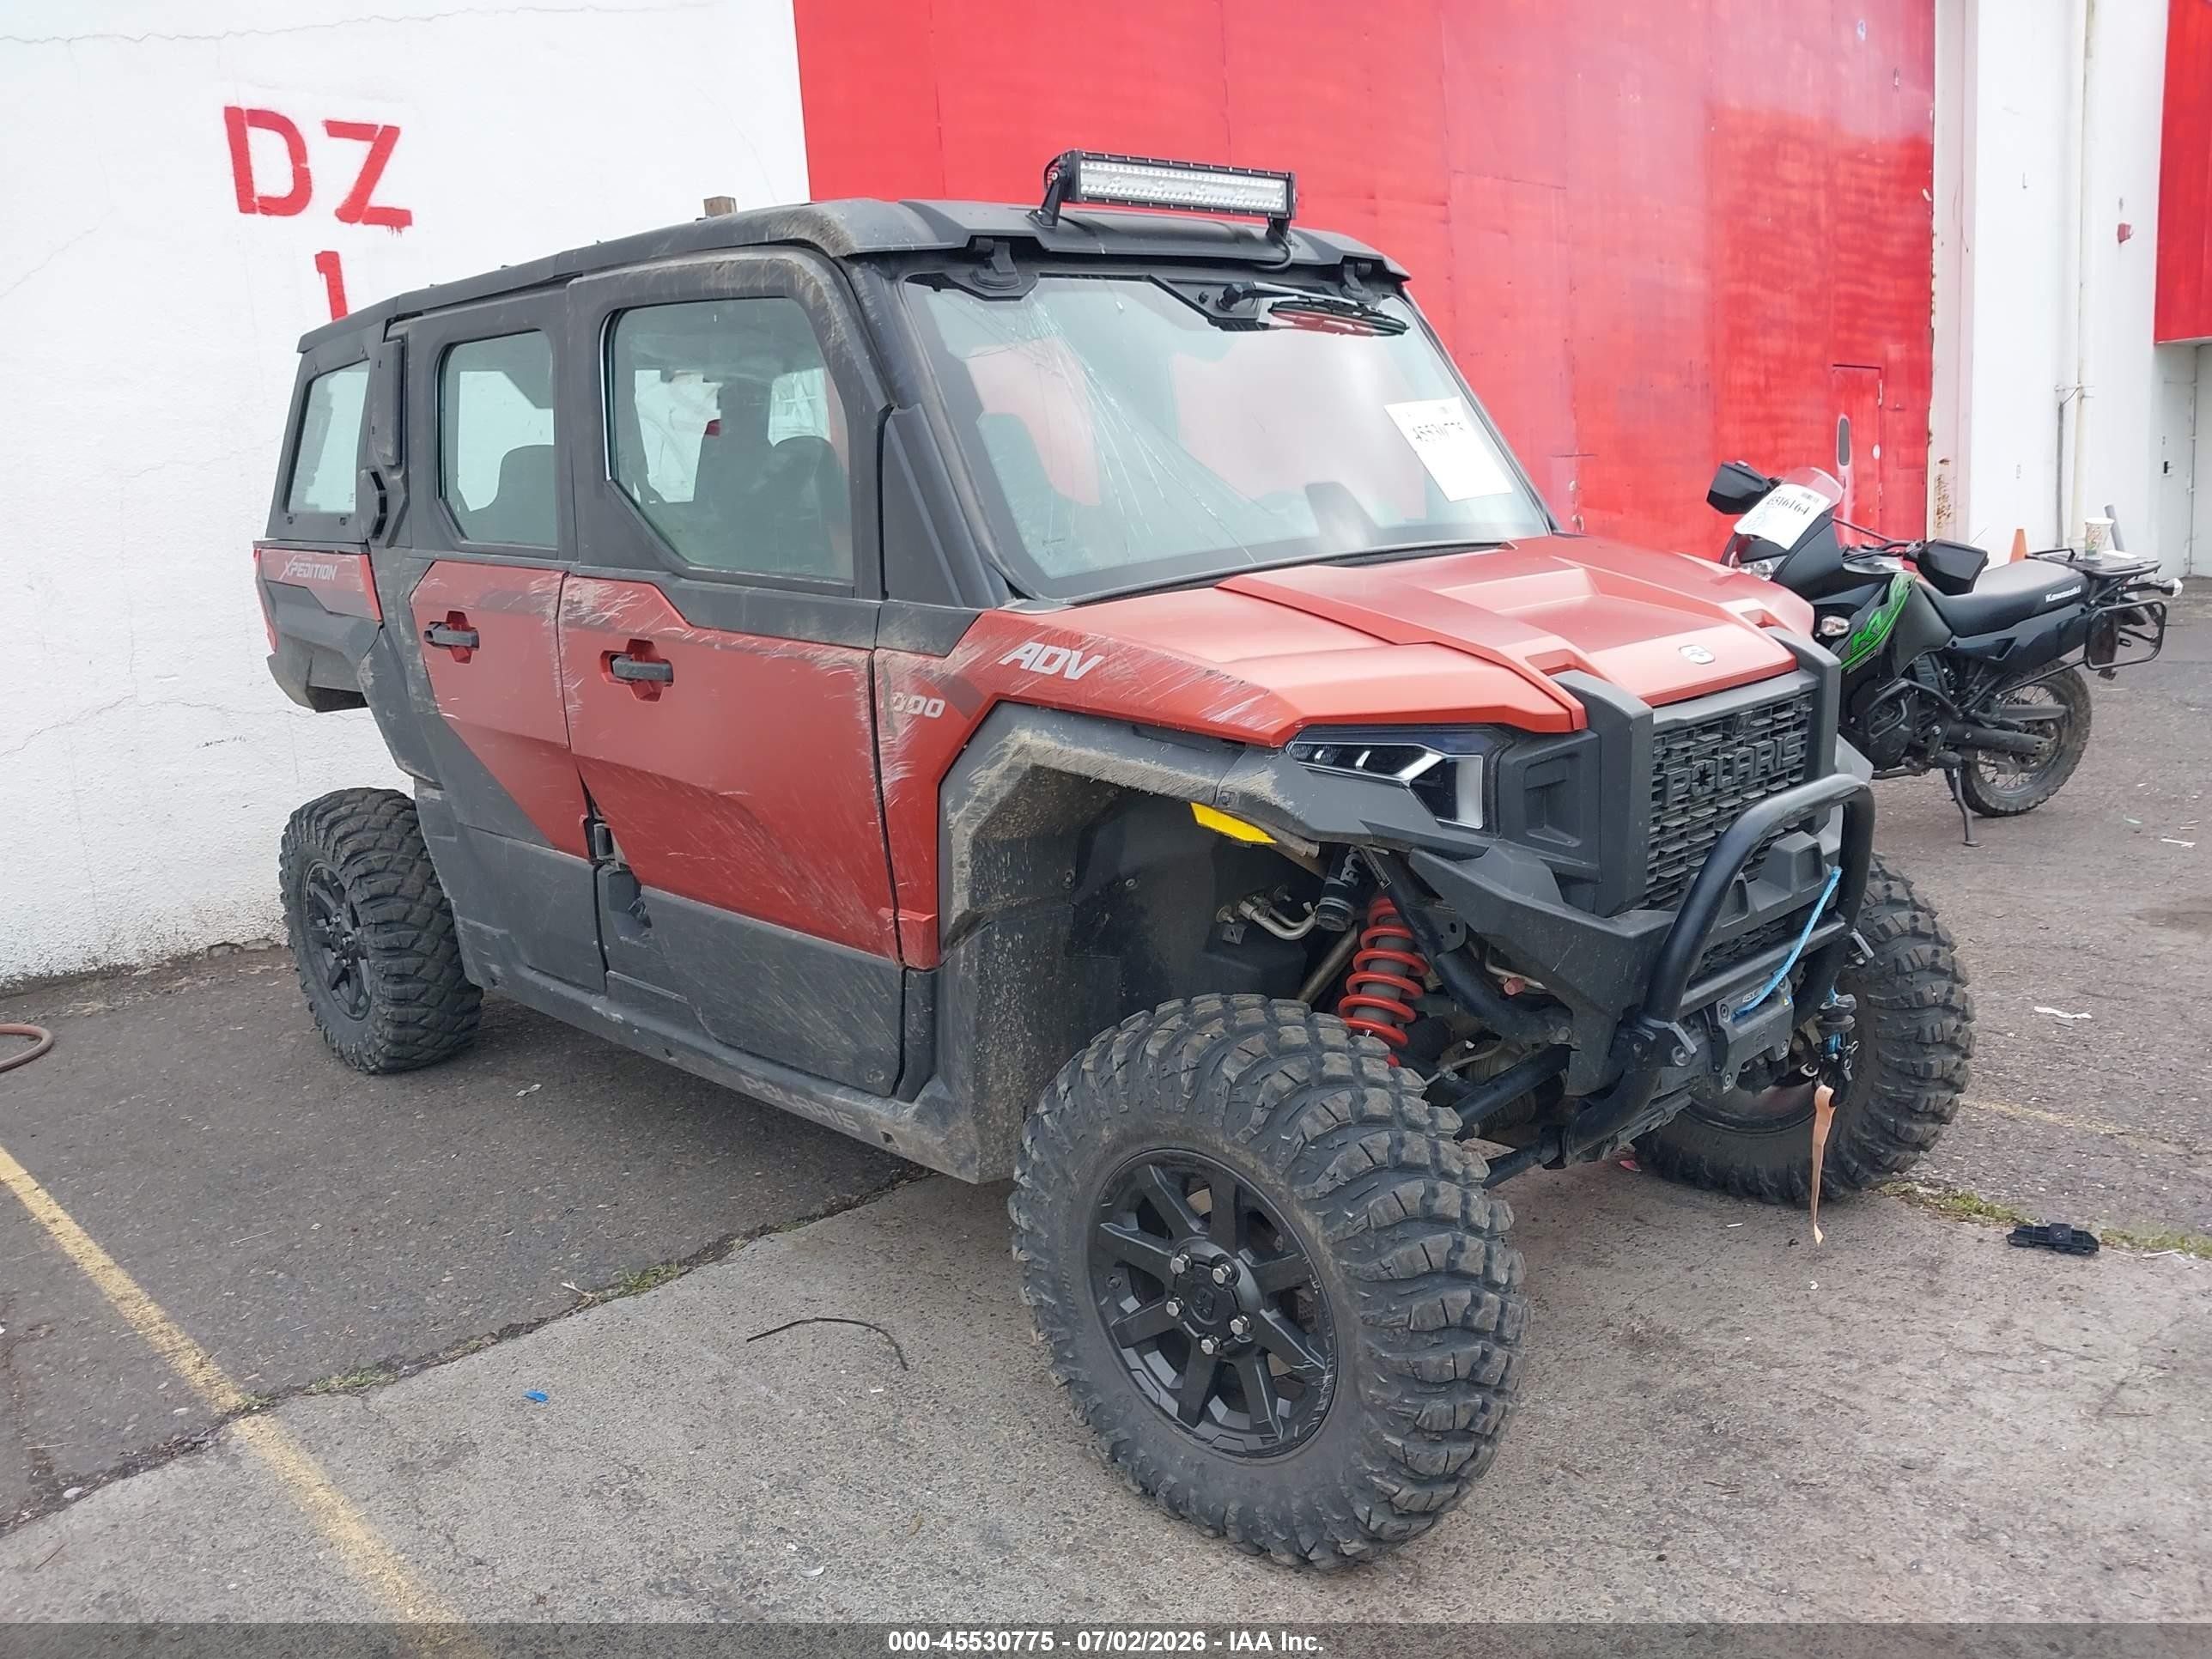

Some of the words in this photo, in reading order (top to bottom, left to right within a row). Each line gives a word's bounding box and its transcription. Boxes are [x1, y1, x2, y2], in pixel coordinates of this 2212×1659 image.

[224, 106, 412, 227] DZ
[314, 250, 349, 321] 1
[279, 555, 337, 581] XPEDITION
[998, 641, 1104, 680] ADV
[1664, 731, 1808, 808] POLARIS
[739, 1073, 861, 1132] POLARIS
